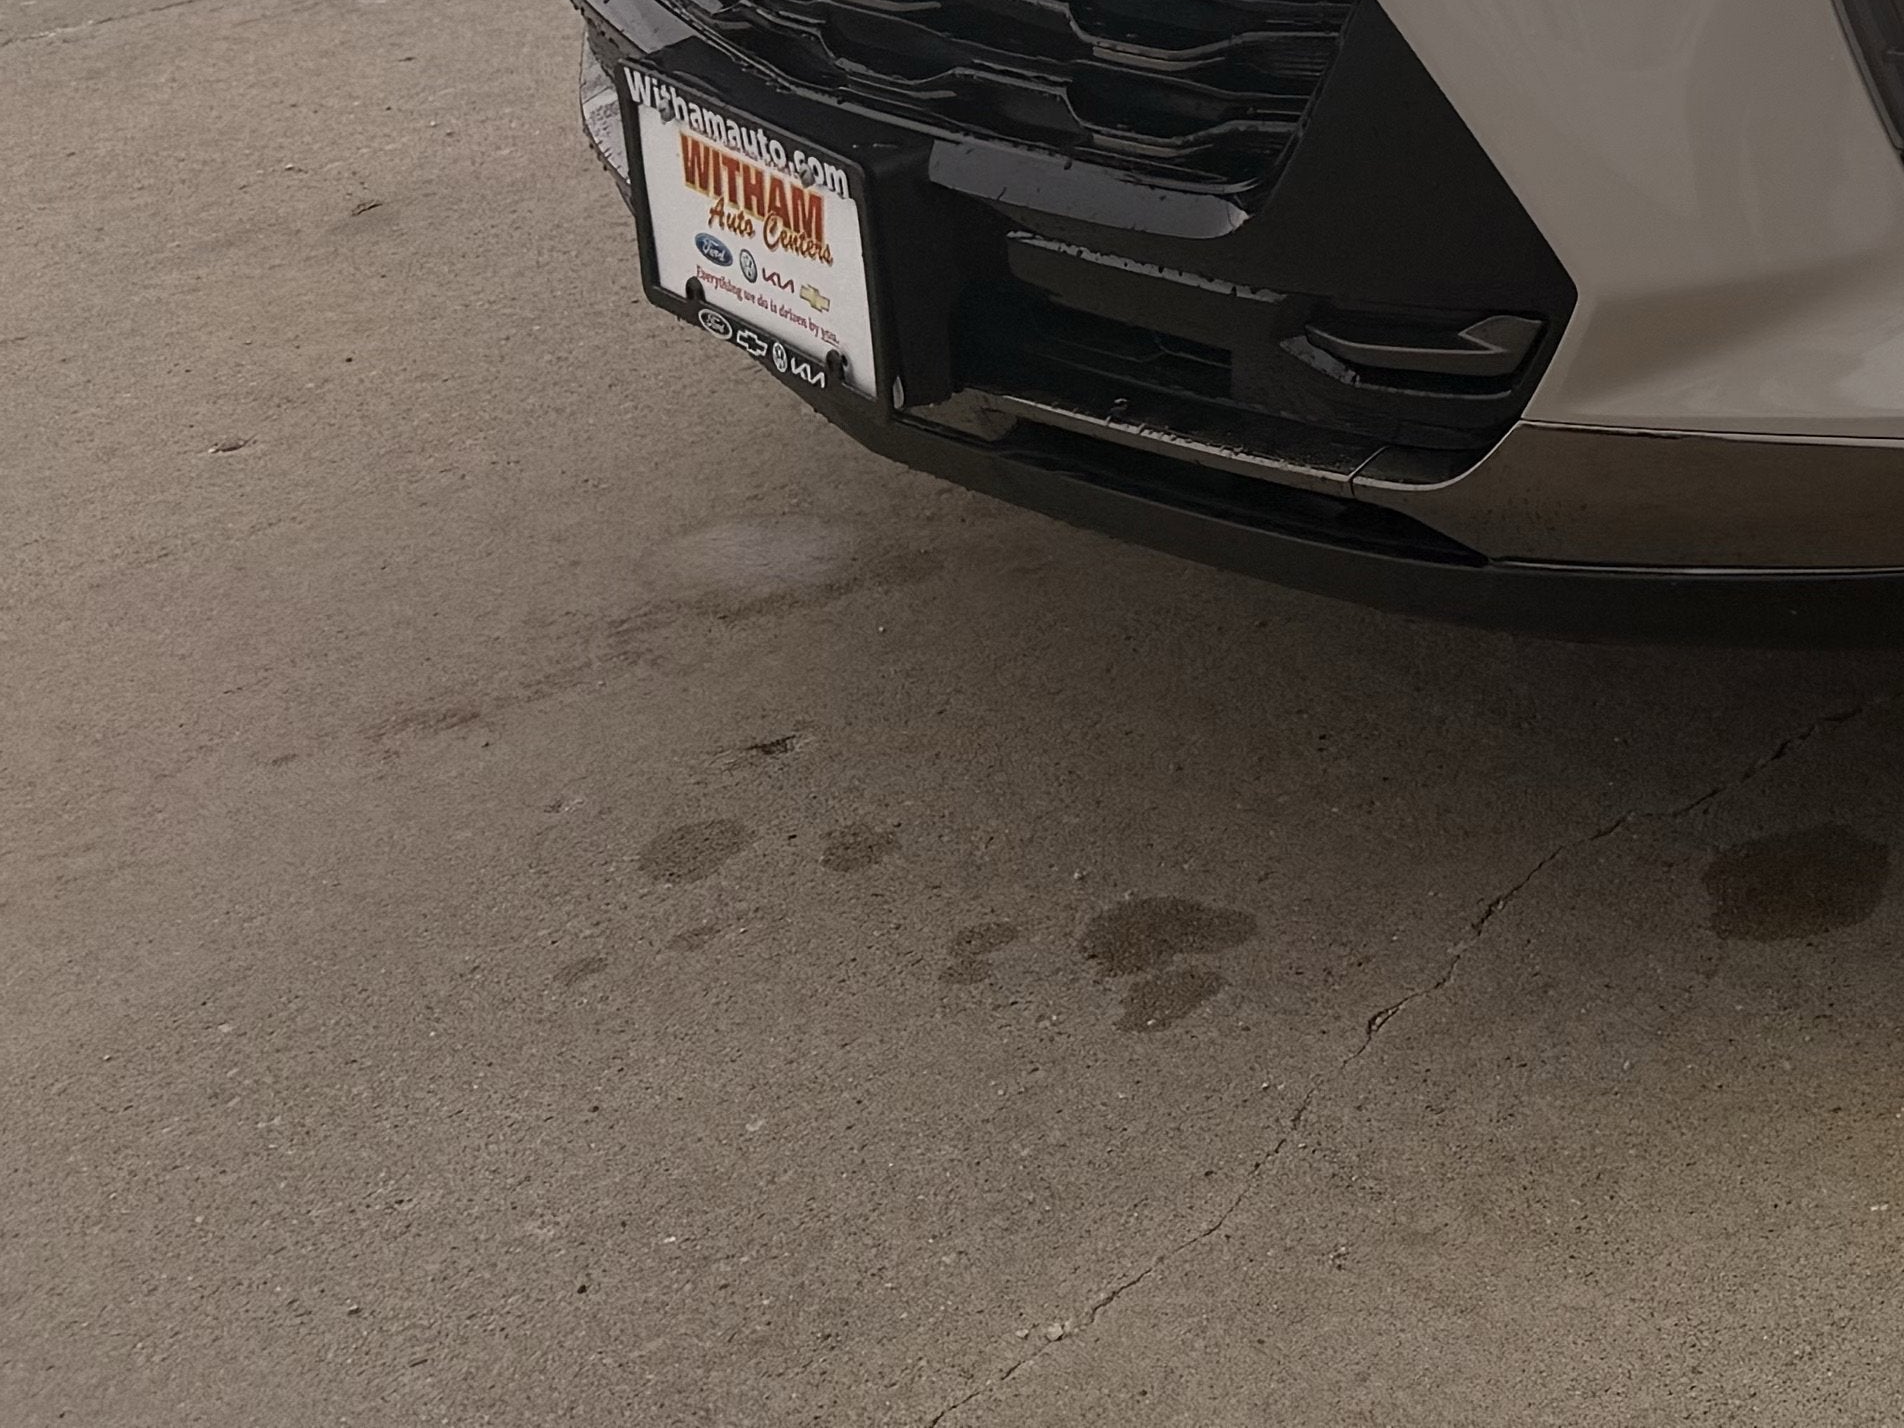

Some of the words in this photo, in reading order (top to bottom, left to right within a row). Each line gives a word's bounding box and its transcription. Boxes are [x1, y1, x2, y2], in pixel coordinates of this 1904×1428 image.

[624, 66, 851, 200] Withamauto.com
[680, 130, 825, 244] WITHAM
[700, 237, 728, 263] Ford
[707, 197, 755, 238] Auto
[763, 211, 834, 266] Centers
[695, 265, 743, 303] Everything
[743, 291, 756, 305] we
[757, 292, 769, 310] do
[770, 299, 778, 314] is
[779, 303, 808, 330] driven
[809, 317, 819, 338] by
